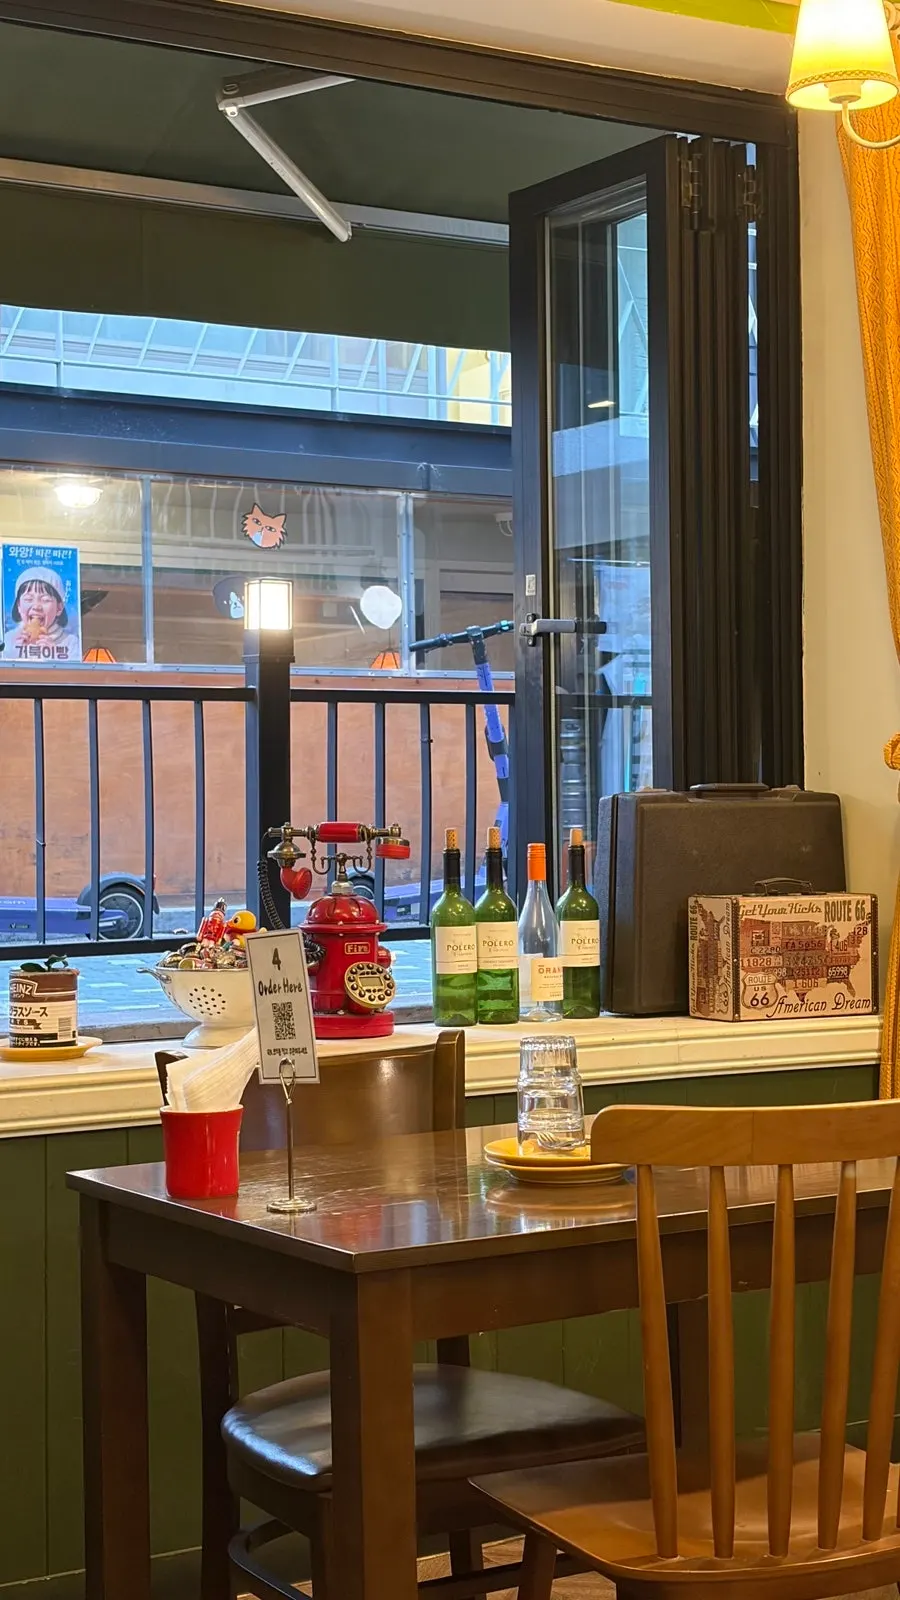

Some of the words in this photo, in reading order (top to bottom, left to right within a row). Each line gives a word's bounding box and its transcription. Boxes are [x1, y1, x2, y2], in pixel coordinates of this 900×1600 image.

[15, 645, 69, 660] 거북이빵
[824, 900, 852, 922] ROUTE
[855, 900, 866, 921] 66
[690, 917, 698, 941] ROUTE
[347, 944, 368, 953] Fire
[482, 940, 514, 948] POLERO
[271, 947, 282, 971] 4
[258, 978, 281, 997] Order
[282, 977, 303, 993] Here
[748, 975, 773, 984] ROUTE
[750, 991, 770, 1007] 66
[766, 995, 827, 1018] American
[831, 992, 871, 1011] Dream
